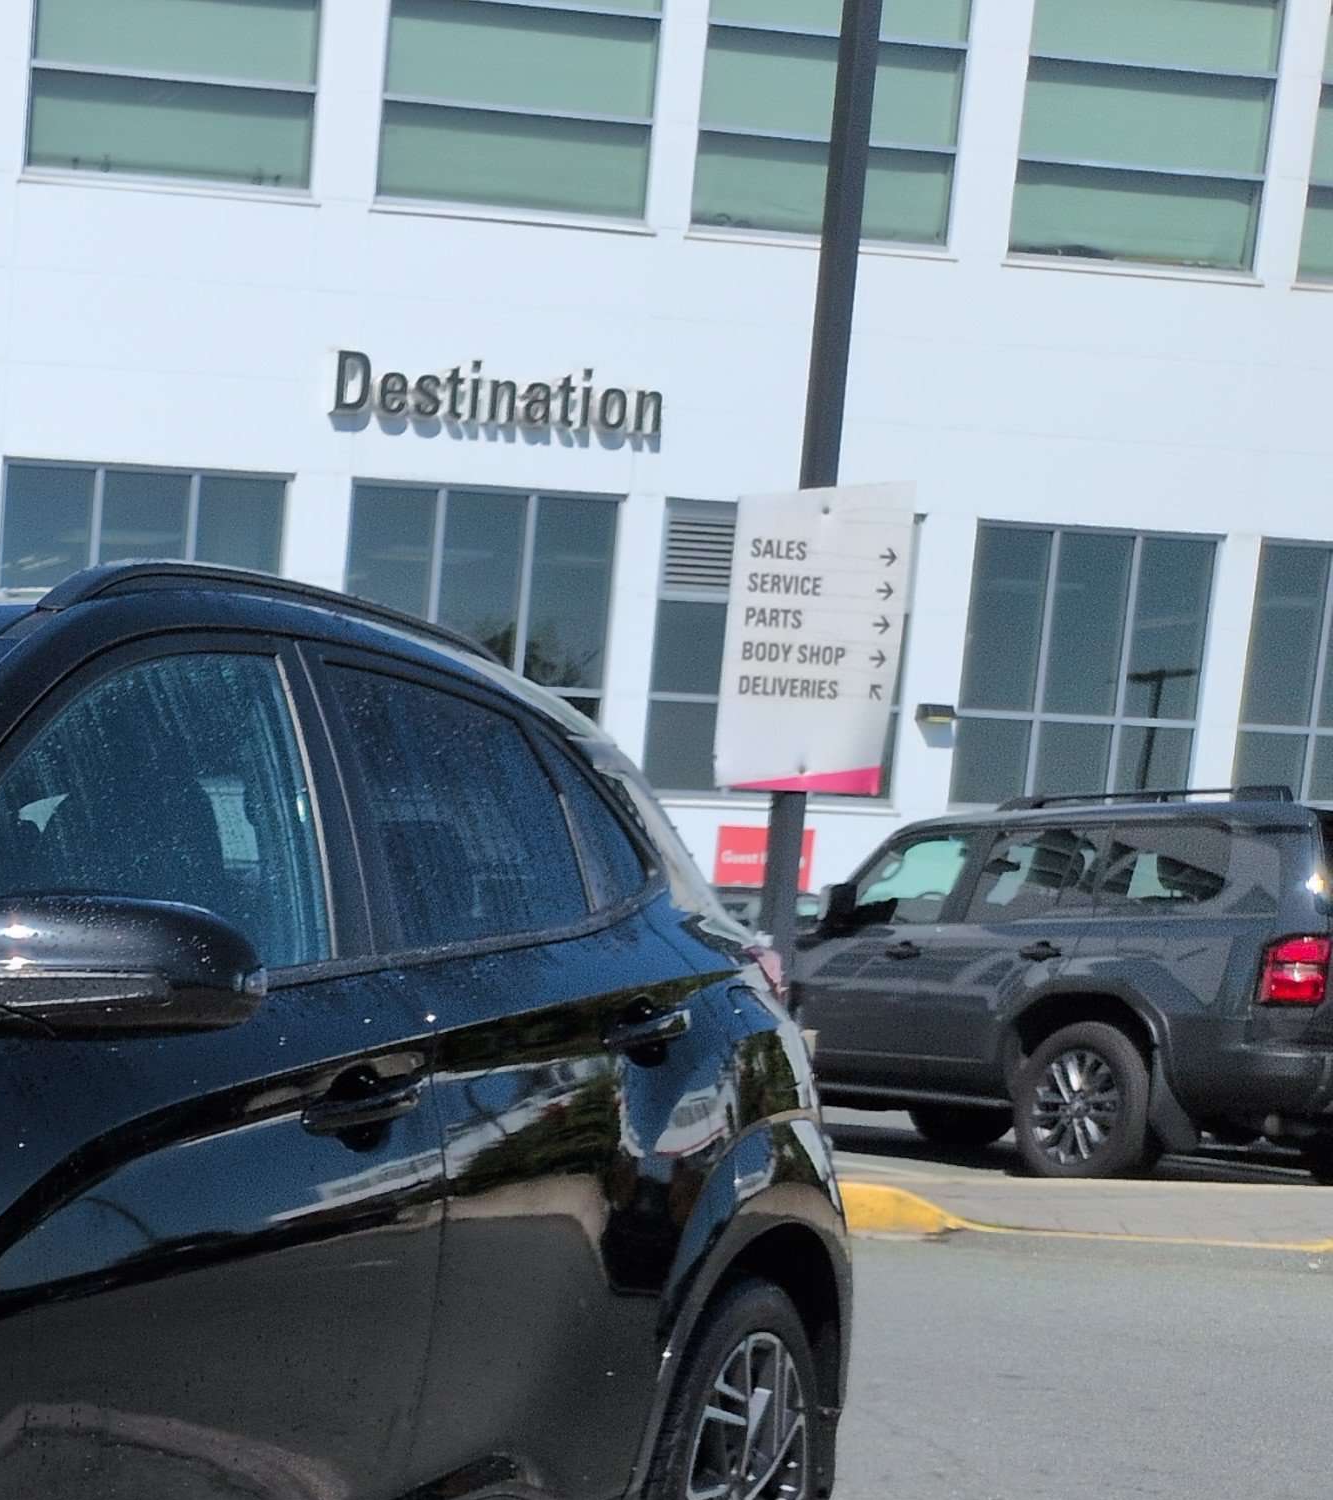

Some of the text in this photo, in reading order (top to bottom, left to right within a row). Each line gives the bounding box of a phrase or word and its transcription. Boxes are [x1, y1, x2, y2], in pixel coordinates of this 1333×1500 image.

[330, 349, 664, 437] Destination
[750, 538, 808, 561] SALES
[747, 572, 823, 596] SERVICE
[744, 606, 803, 629] PARTS
[741, 641, 846, 666] BODY SHOP
[738, 675, 839, 700] DELIVERIES
